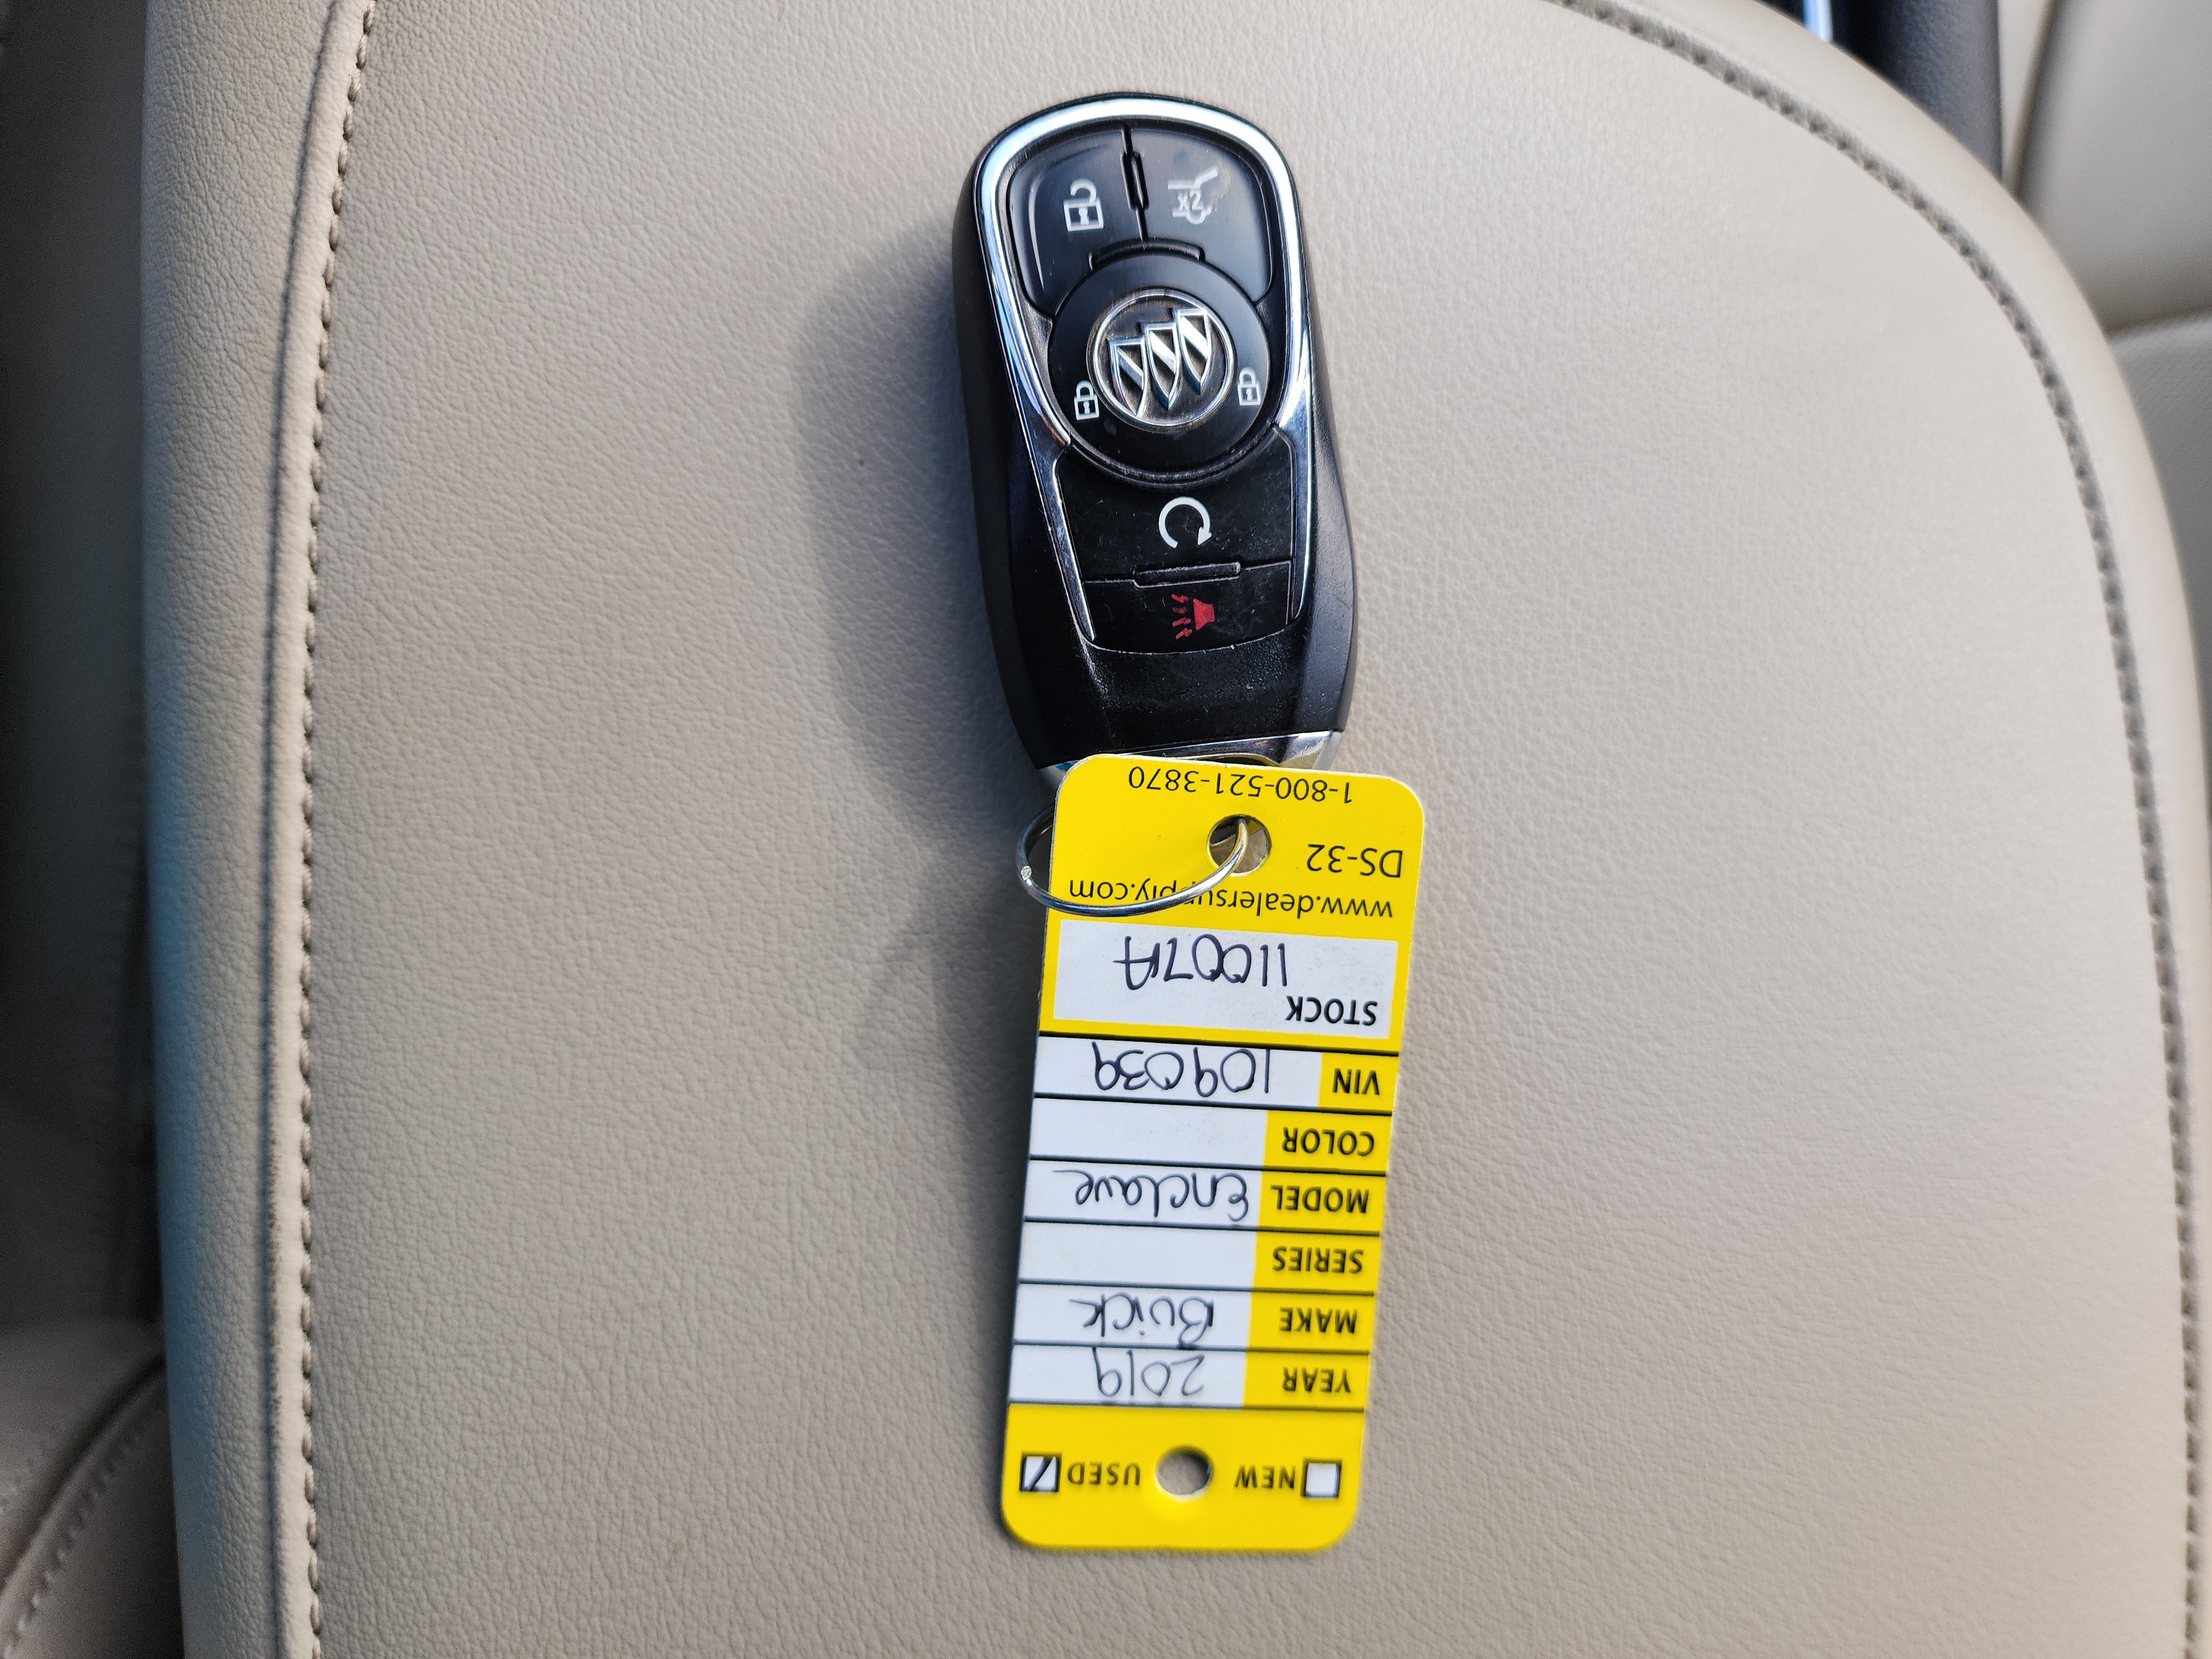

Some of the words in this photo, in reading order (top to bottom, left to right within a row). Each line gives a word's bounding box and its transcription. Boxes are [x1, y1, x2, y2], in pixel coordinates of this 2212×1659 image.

[1128, 766, 1353, 804] 1-800-521-3870
[1307, 843, 1403, 878] DS-32
[1113, 933, 1287, 990] 11007A
[1285, 995, 1378, 1026] STOCK
[1092, 1041, 1271, 1097] 109039
[1333, 1068, 1381, 1095] VIN
[1282, 1126, 1375, 1156] COLOR
[1053, 1169, 1249, 1222] Enclave
[1270, 1185, 1370, 1214] MODEL
[1272, 1246, 1363, 1274] SERIES
[1068, 1292, 1214, 1350] Buick
[1279, 1307, 1358, 1334] MAKE
[1091, 1347, 1205, 1397] 2019
[1282, 1366, 1352, 1393] YEAR
[1067, 1462, 1141, 1486] USED
[1234, 1465, 1296, 1489] NEW
